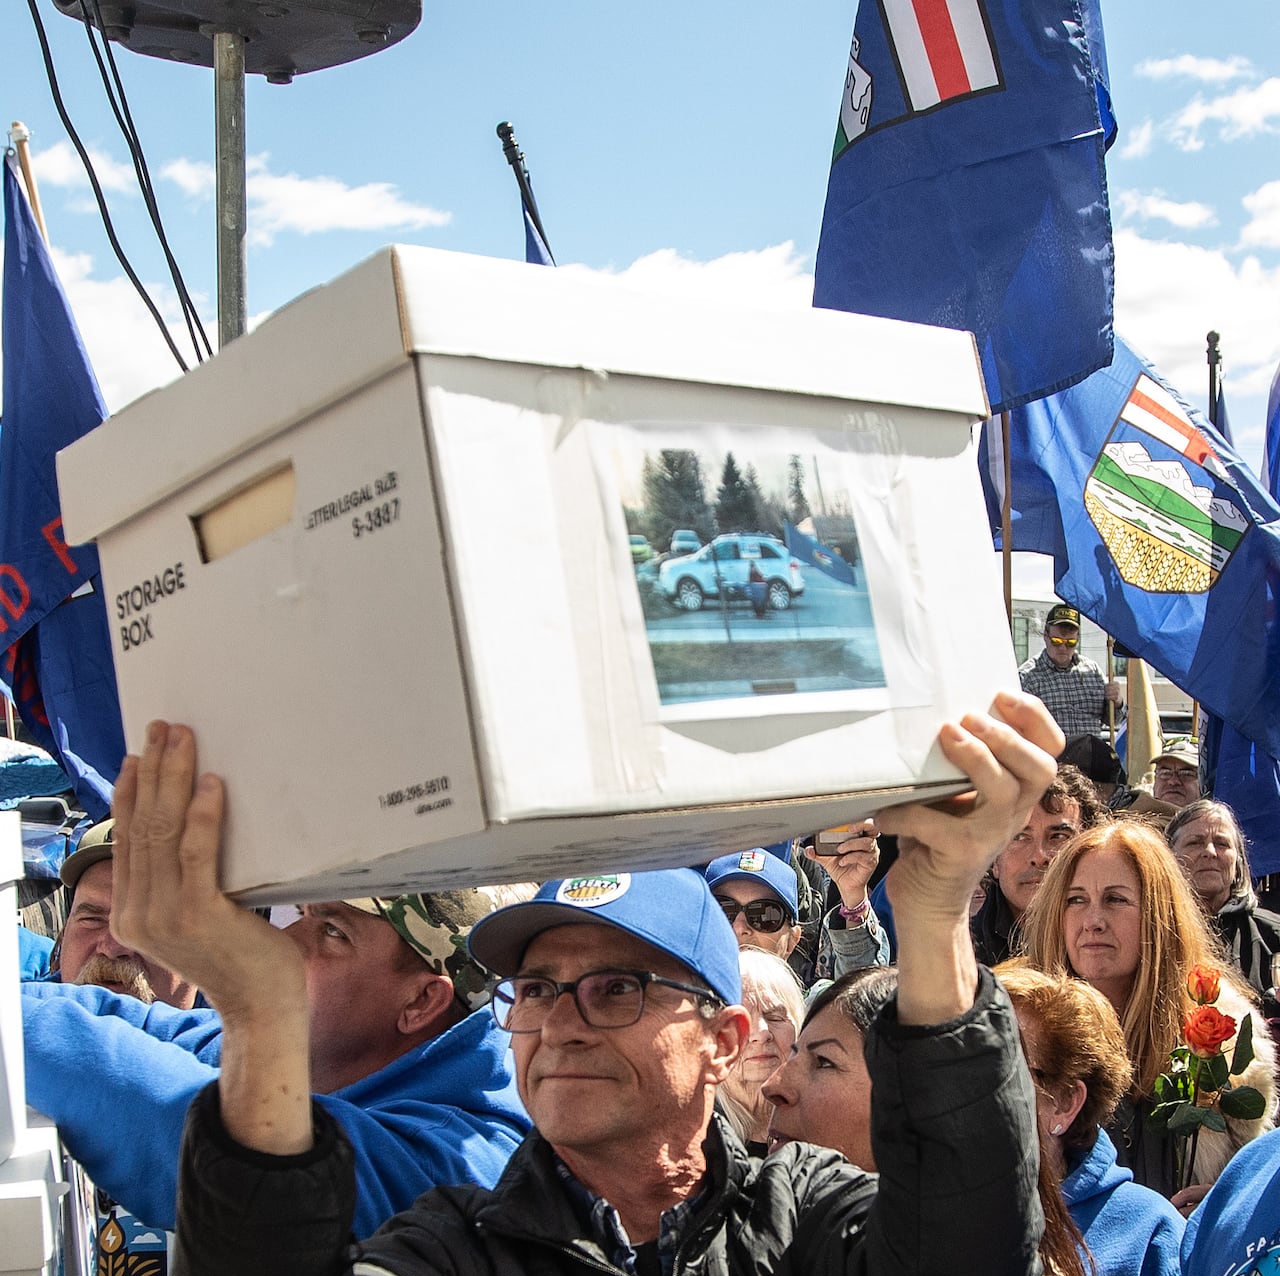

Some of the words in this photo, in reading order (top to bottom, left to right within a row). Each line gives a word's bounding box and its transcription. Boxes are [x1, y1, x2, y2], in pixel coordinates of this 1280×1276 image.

[352, 499, 402, 539] S-3887
[116, 562, 186, 620] STORAGE
[120, 613, 154, 651] BOX
